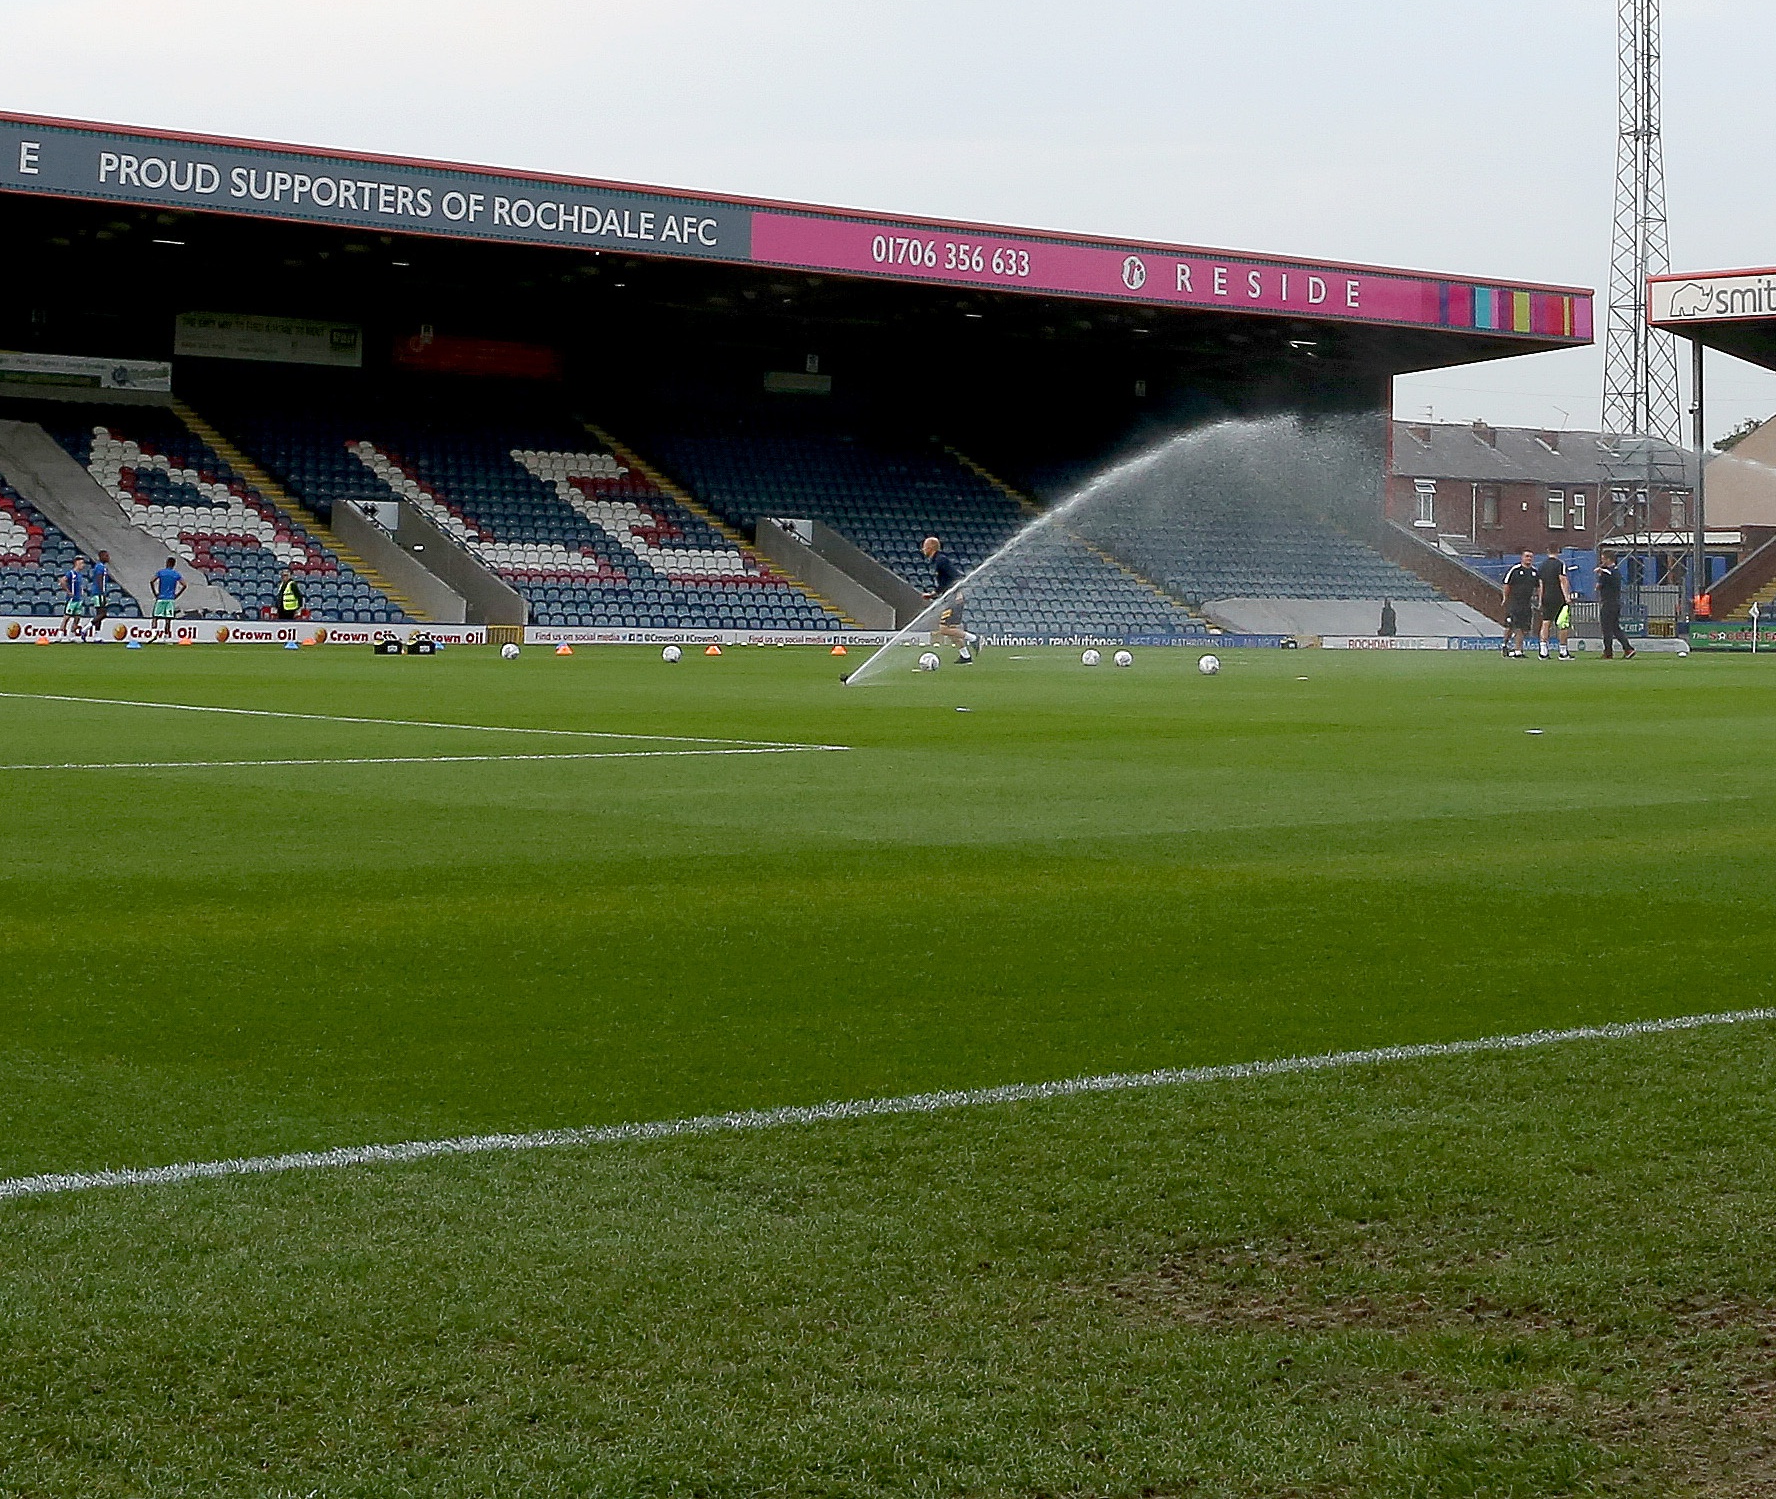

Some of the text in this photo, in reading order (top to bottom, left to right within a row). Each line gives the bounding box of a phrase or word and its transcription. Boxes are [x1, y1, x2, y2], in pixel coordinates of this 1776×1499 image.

[99, 151, 718, 246] PROUD SUPPORTERS OF ROCHDALE AFC
[872, 235, 1030, 277] 01706 356 633
[1176, 263, 1360, 308] RESIDE
[232, 628, 297, 641] Crown Oil
[330, 630, 369, 642] Crown
[464, 632, 484, 644] Oil
[535, 632, 551, 641] Find
[575, 632, 596, 641] social
